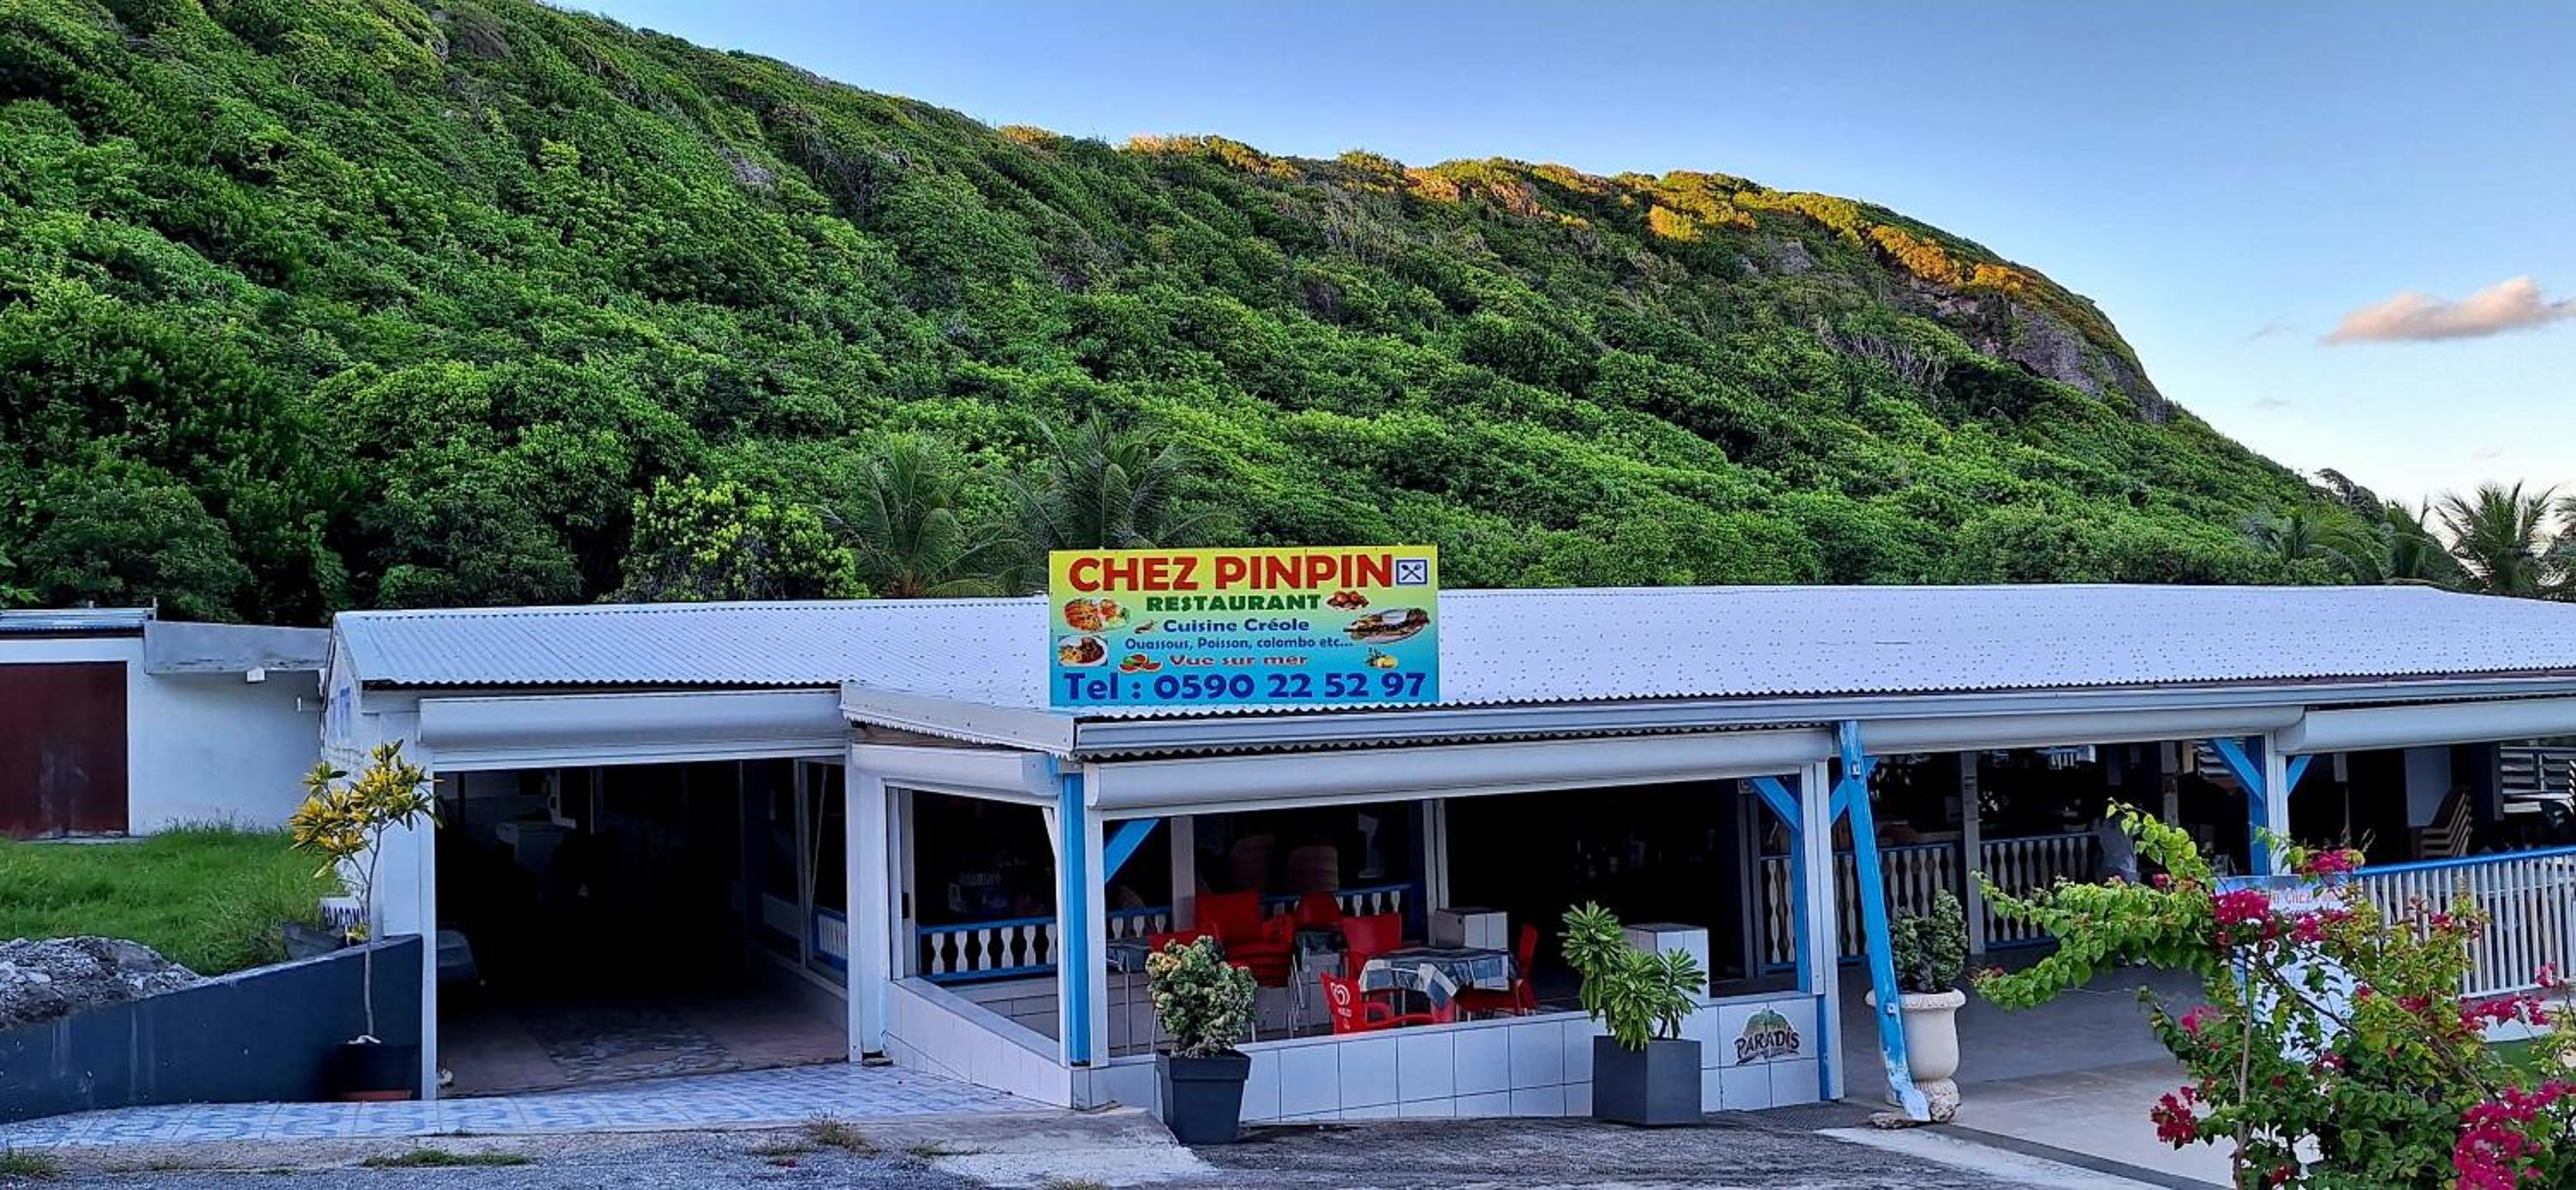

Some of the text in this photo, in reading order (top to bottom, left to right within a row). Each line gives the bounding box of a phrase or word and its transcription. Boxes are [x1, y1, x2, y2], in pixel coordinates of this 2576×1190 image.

[1068, 554, 1394, 592] CHEZ PINPIN
[1146, 594, 1321, 612] RESTAURANT
[1163, 617, 1309, 634] Cuisine Créole
[1125, 637, 1194, 651] Ouassous,
[1197, 636, 1253, 650] Poisson,
[1256, 636, 1316, 648] colombo
[1169, 654, 1309, 666] Vue sur mer
[1063, 671, 1119, 700] Tel
[1153, 673, 1255, 700] 0590
[1267, 673, 1314, 698] 22
[1324, 672, 1370, 698] 52
[1381, 671, 1427, 697] 97
[1734, 1026, 1801, 1059] PARADIS
